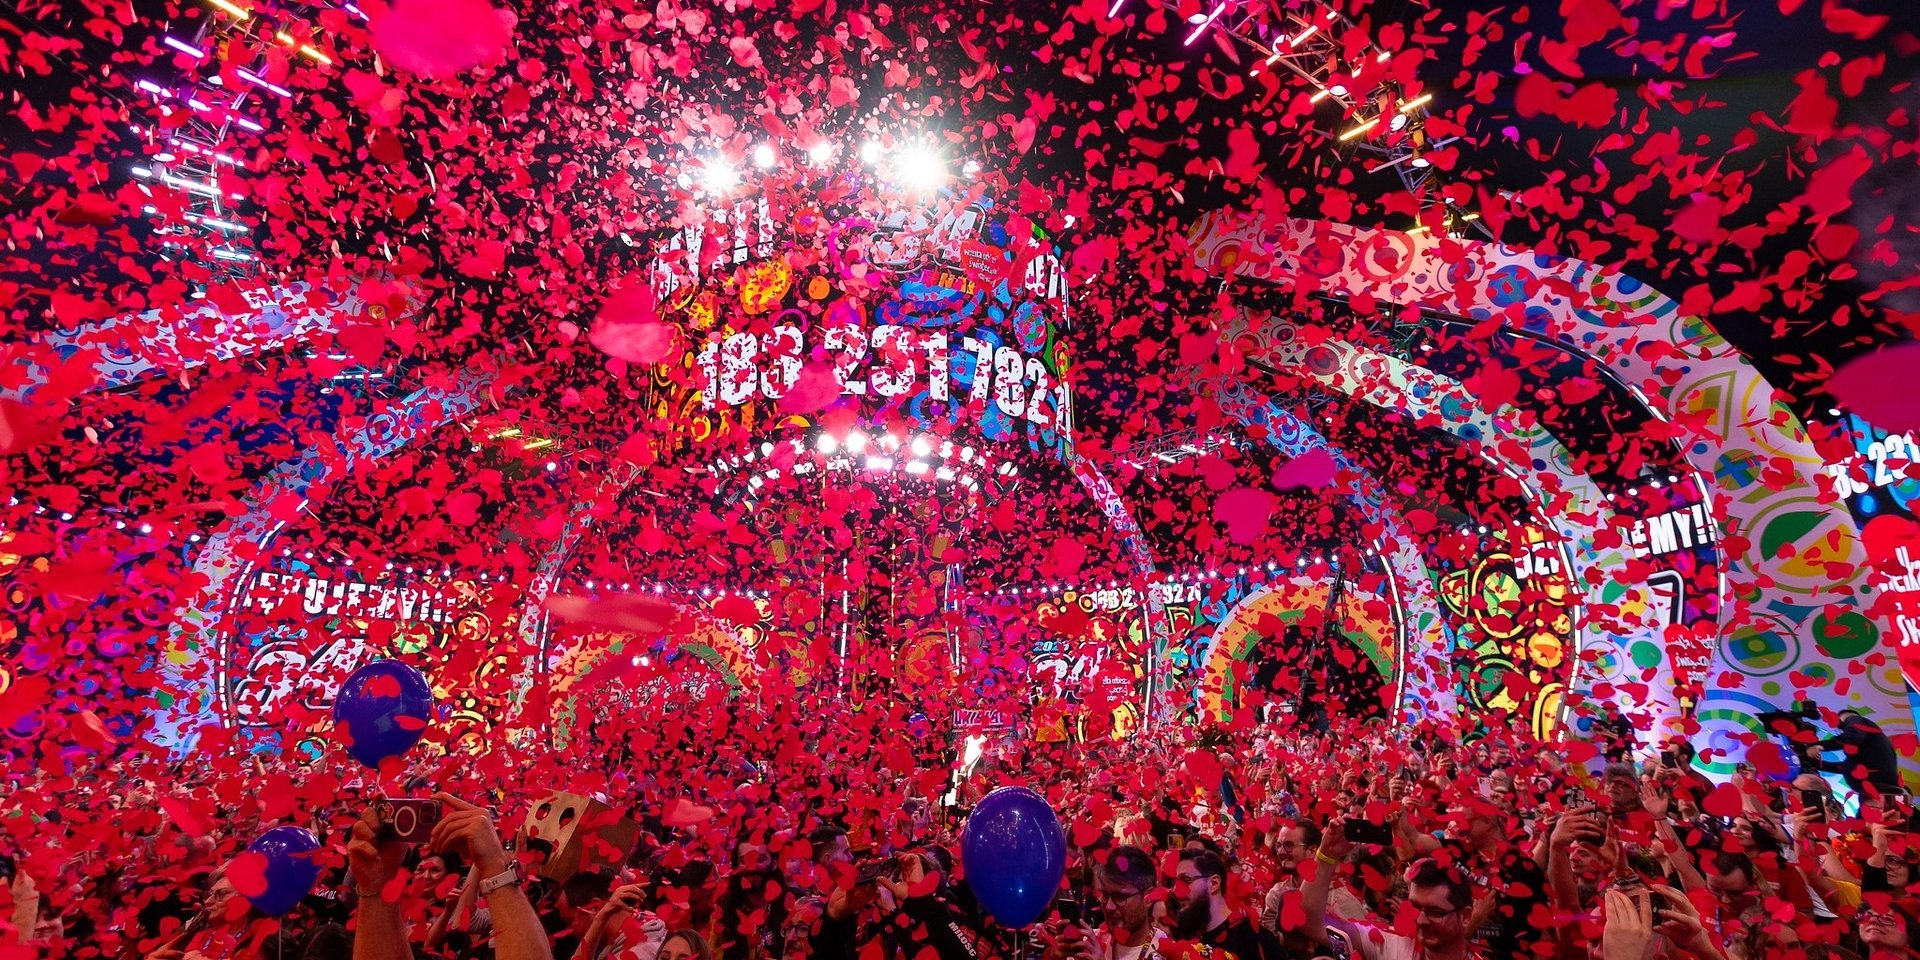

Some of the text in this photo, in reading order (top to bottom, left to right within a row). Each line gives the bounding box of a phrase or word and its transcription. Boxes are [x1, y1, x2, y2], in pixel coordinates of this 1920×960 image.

[696, 325, 803, 411] 183
[824, 323, 949, 401] 231
[963, 336, 1049, 425] 782
